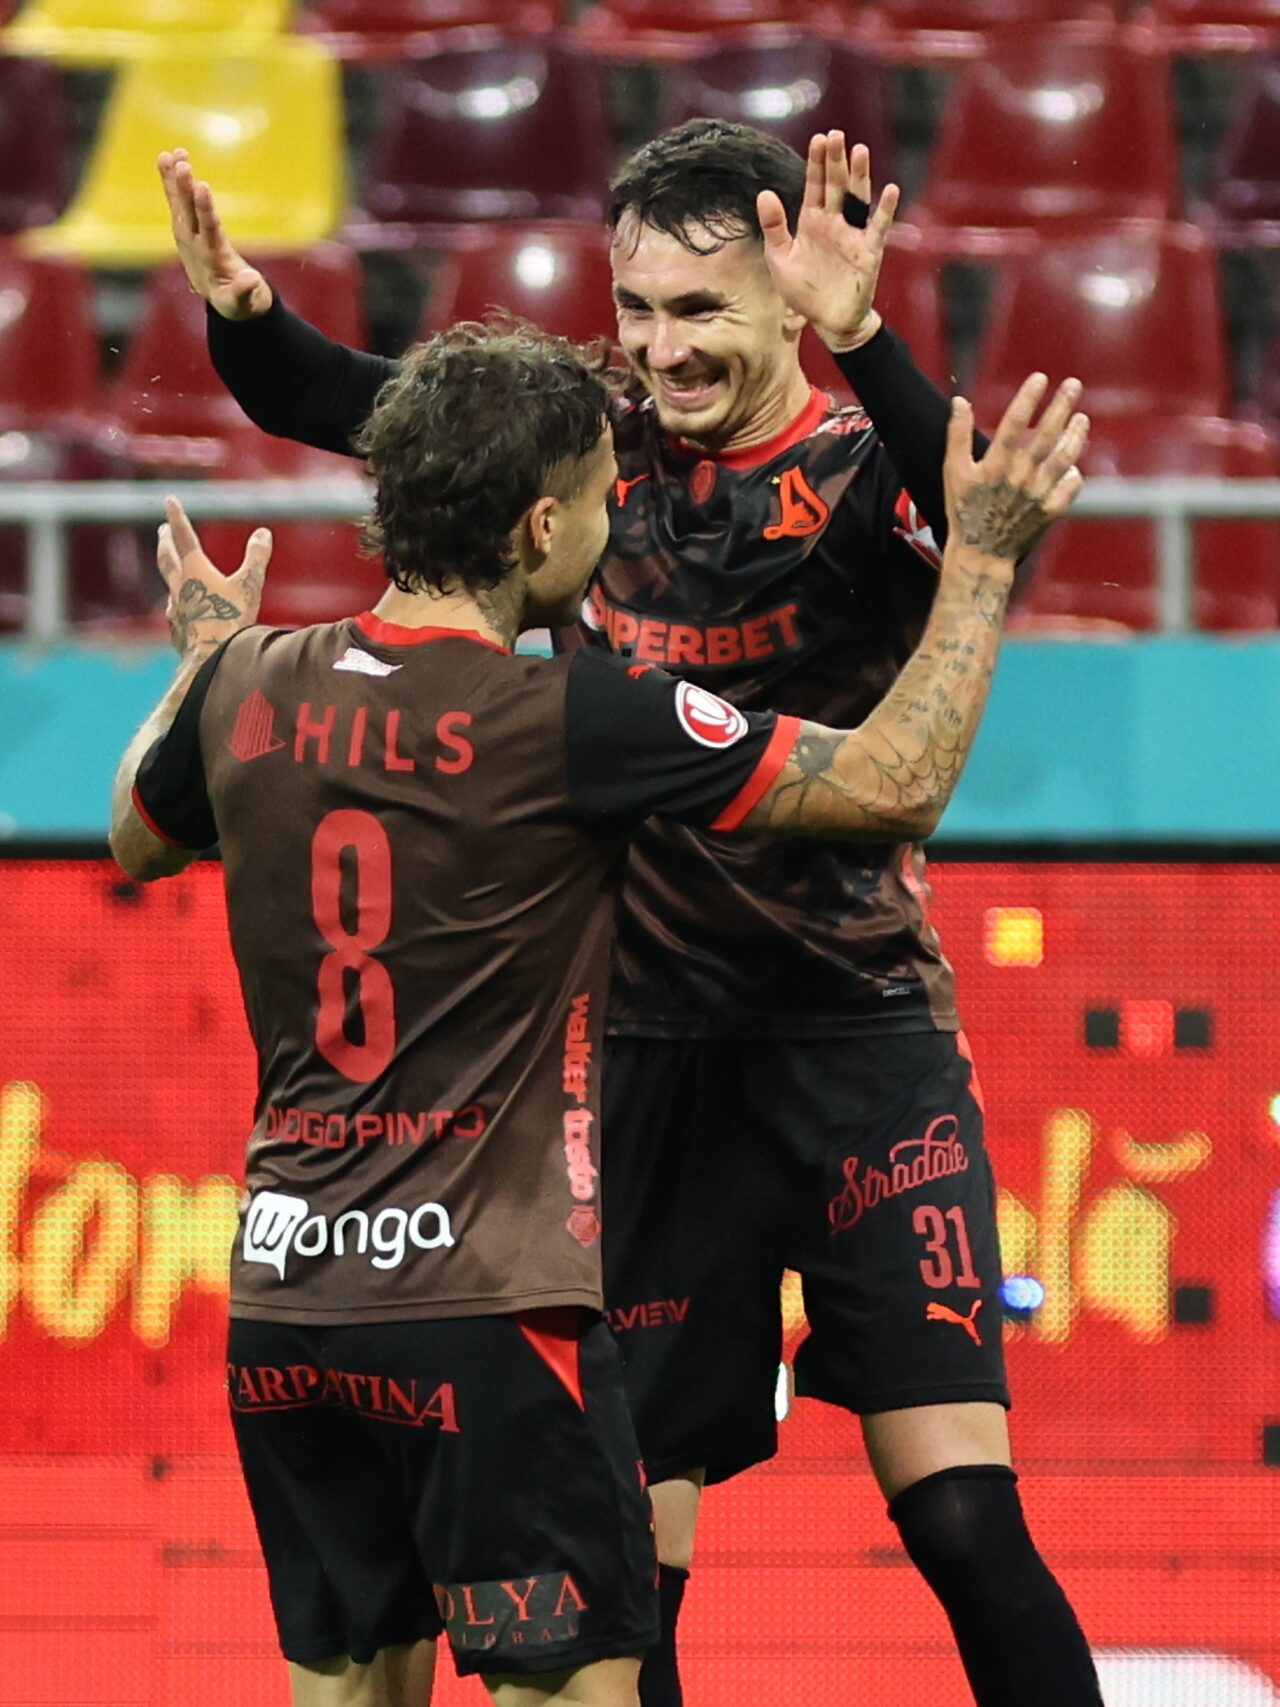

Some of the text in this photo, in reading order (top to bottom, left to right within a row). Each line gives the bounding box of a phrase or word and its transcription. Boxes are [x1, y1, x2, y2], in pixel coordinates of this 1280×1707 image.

[294, 702, 474, 775] HILS
[311, 808, 395, 1084] 8
[265, 1104, 485, 1149] DIOGO PINTO
[563, 992, 599, 1201] walter tosto
[829, 1113, 969, 1236] Stradale
[912, 1204, 982, 1289] 31
